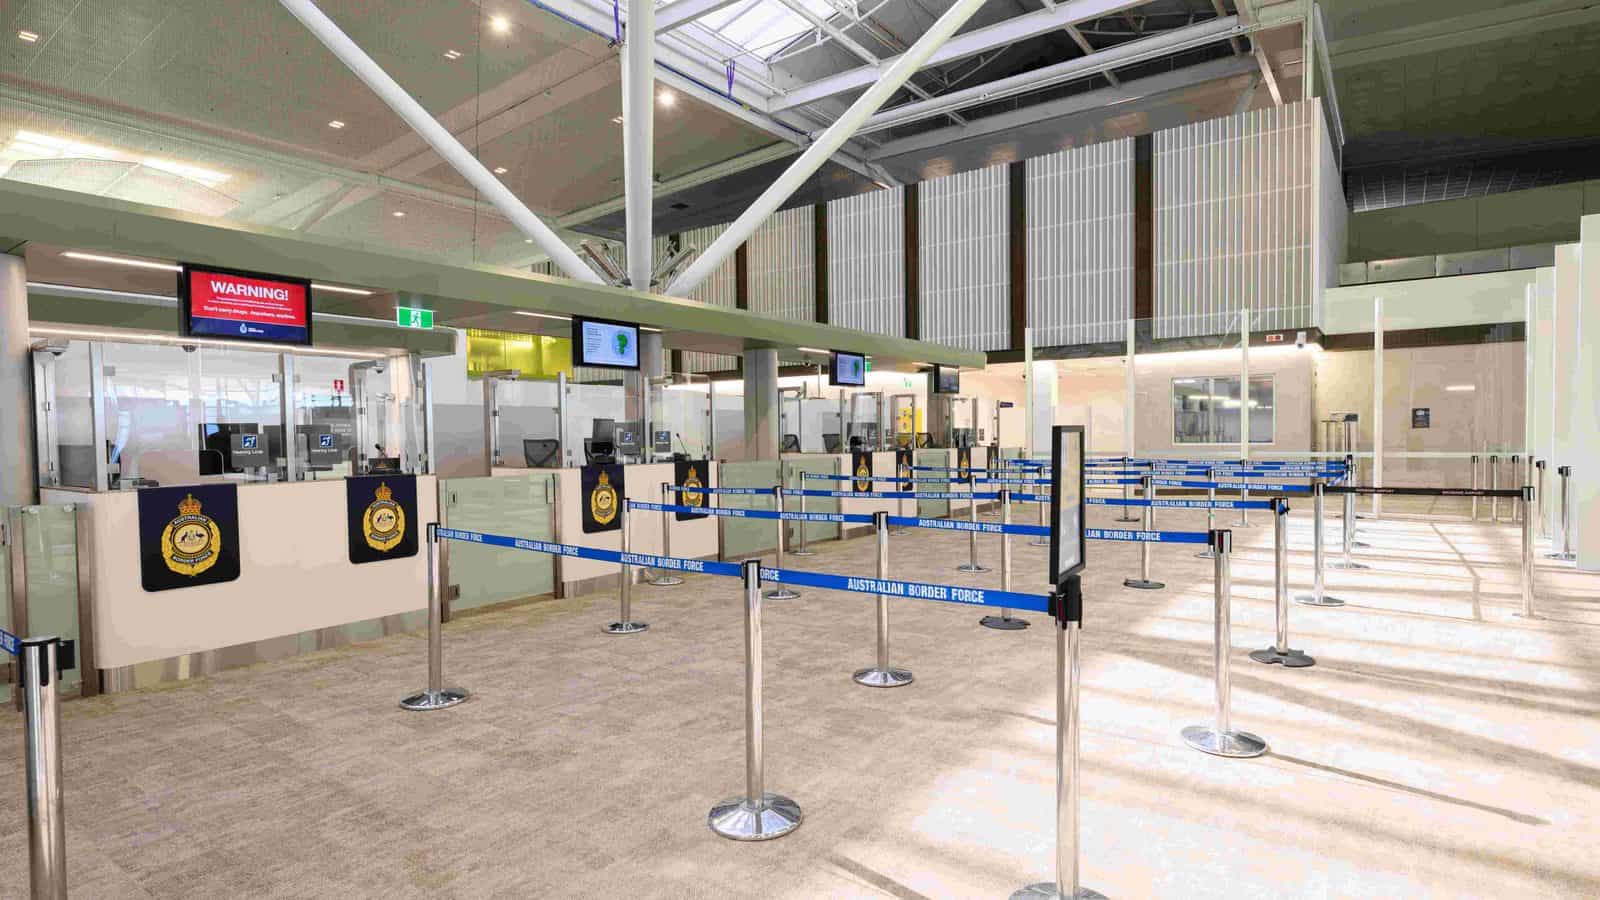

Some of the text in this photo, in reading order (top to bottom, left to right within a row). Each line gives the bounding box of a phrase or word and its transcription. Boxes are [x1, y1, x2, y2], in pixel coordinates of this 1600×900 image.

[210, 280, 288, 301] WARNING!
[918, 519, 1003, 532] AUSTRALIAN BORDER FORCE
[1103, 531, 1133, 540] BORDER
[1136, 532, 1161, 540] FORCE
[515, 538, 578, 556] AUSTRALIAN BORDER FORCE
[621, 552, 704, 572] AUSTRALIAN BORDER FORCE
[760, 568, 780, 581] ORCE
[848, 578, 985, 604] AUSTRALIAN BORDER FORCE
